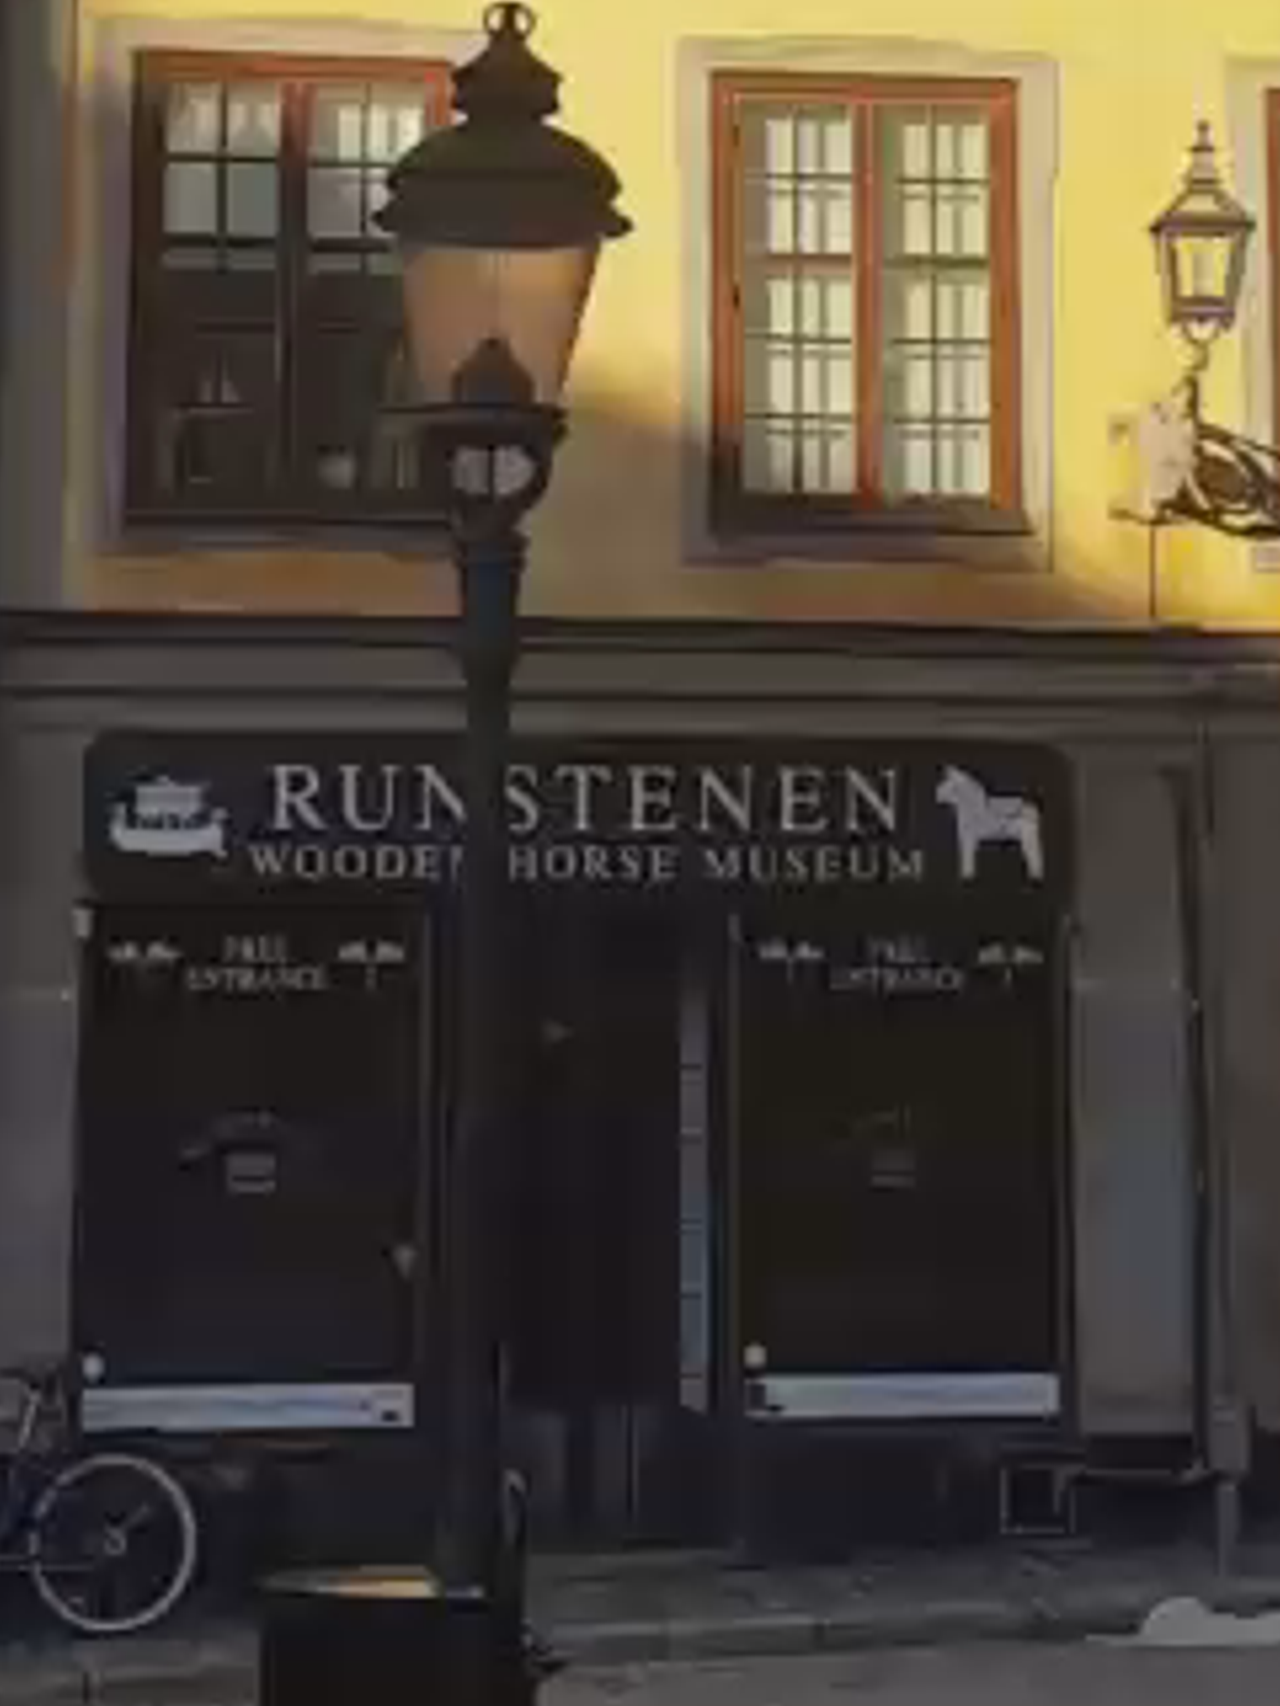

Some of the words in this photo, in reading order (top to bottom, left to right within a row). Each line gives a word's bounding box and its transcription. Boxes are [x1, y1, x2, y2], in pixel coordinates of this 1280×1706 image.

[271, 762, 898, 834] RUNSTENEN
[506, 843, 680, 884] HORSE
[699, 843, 926, 885] MUSEUM
